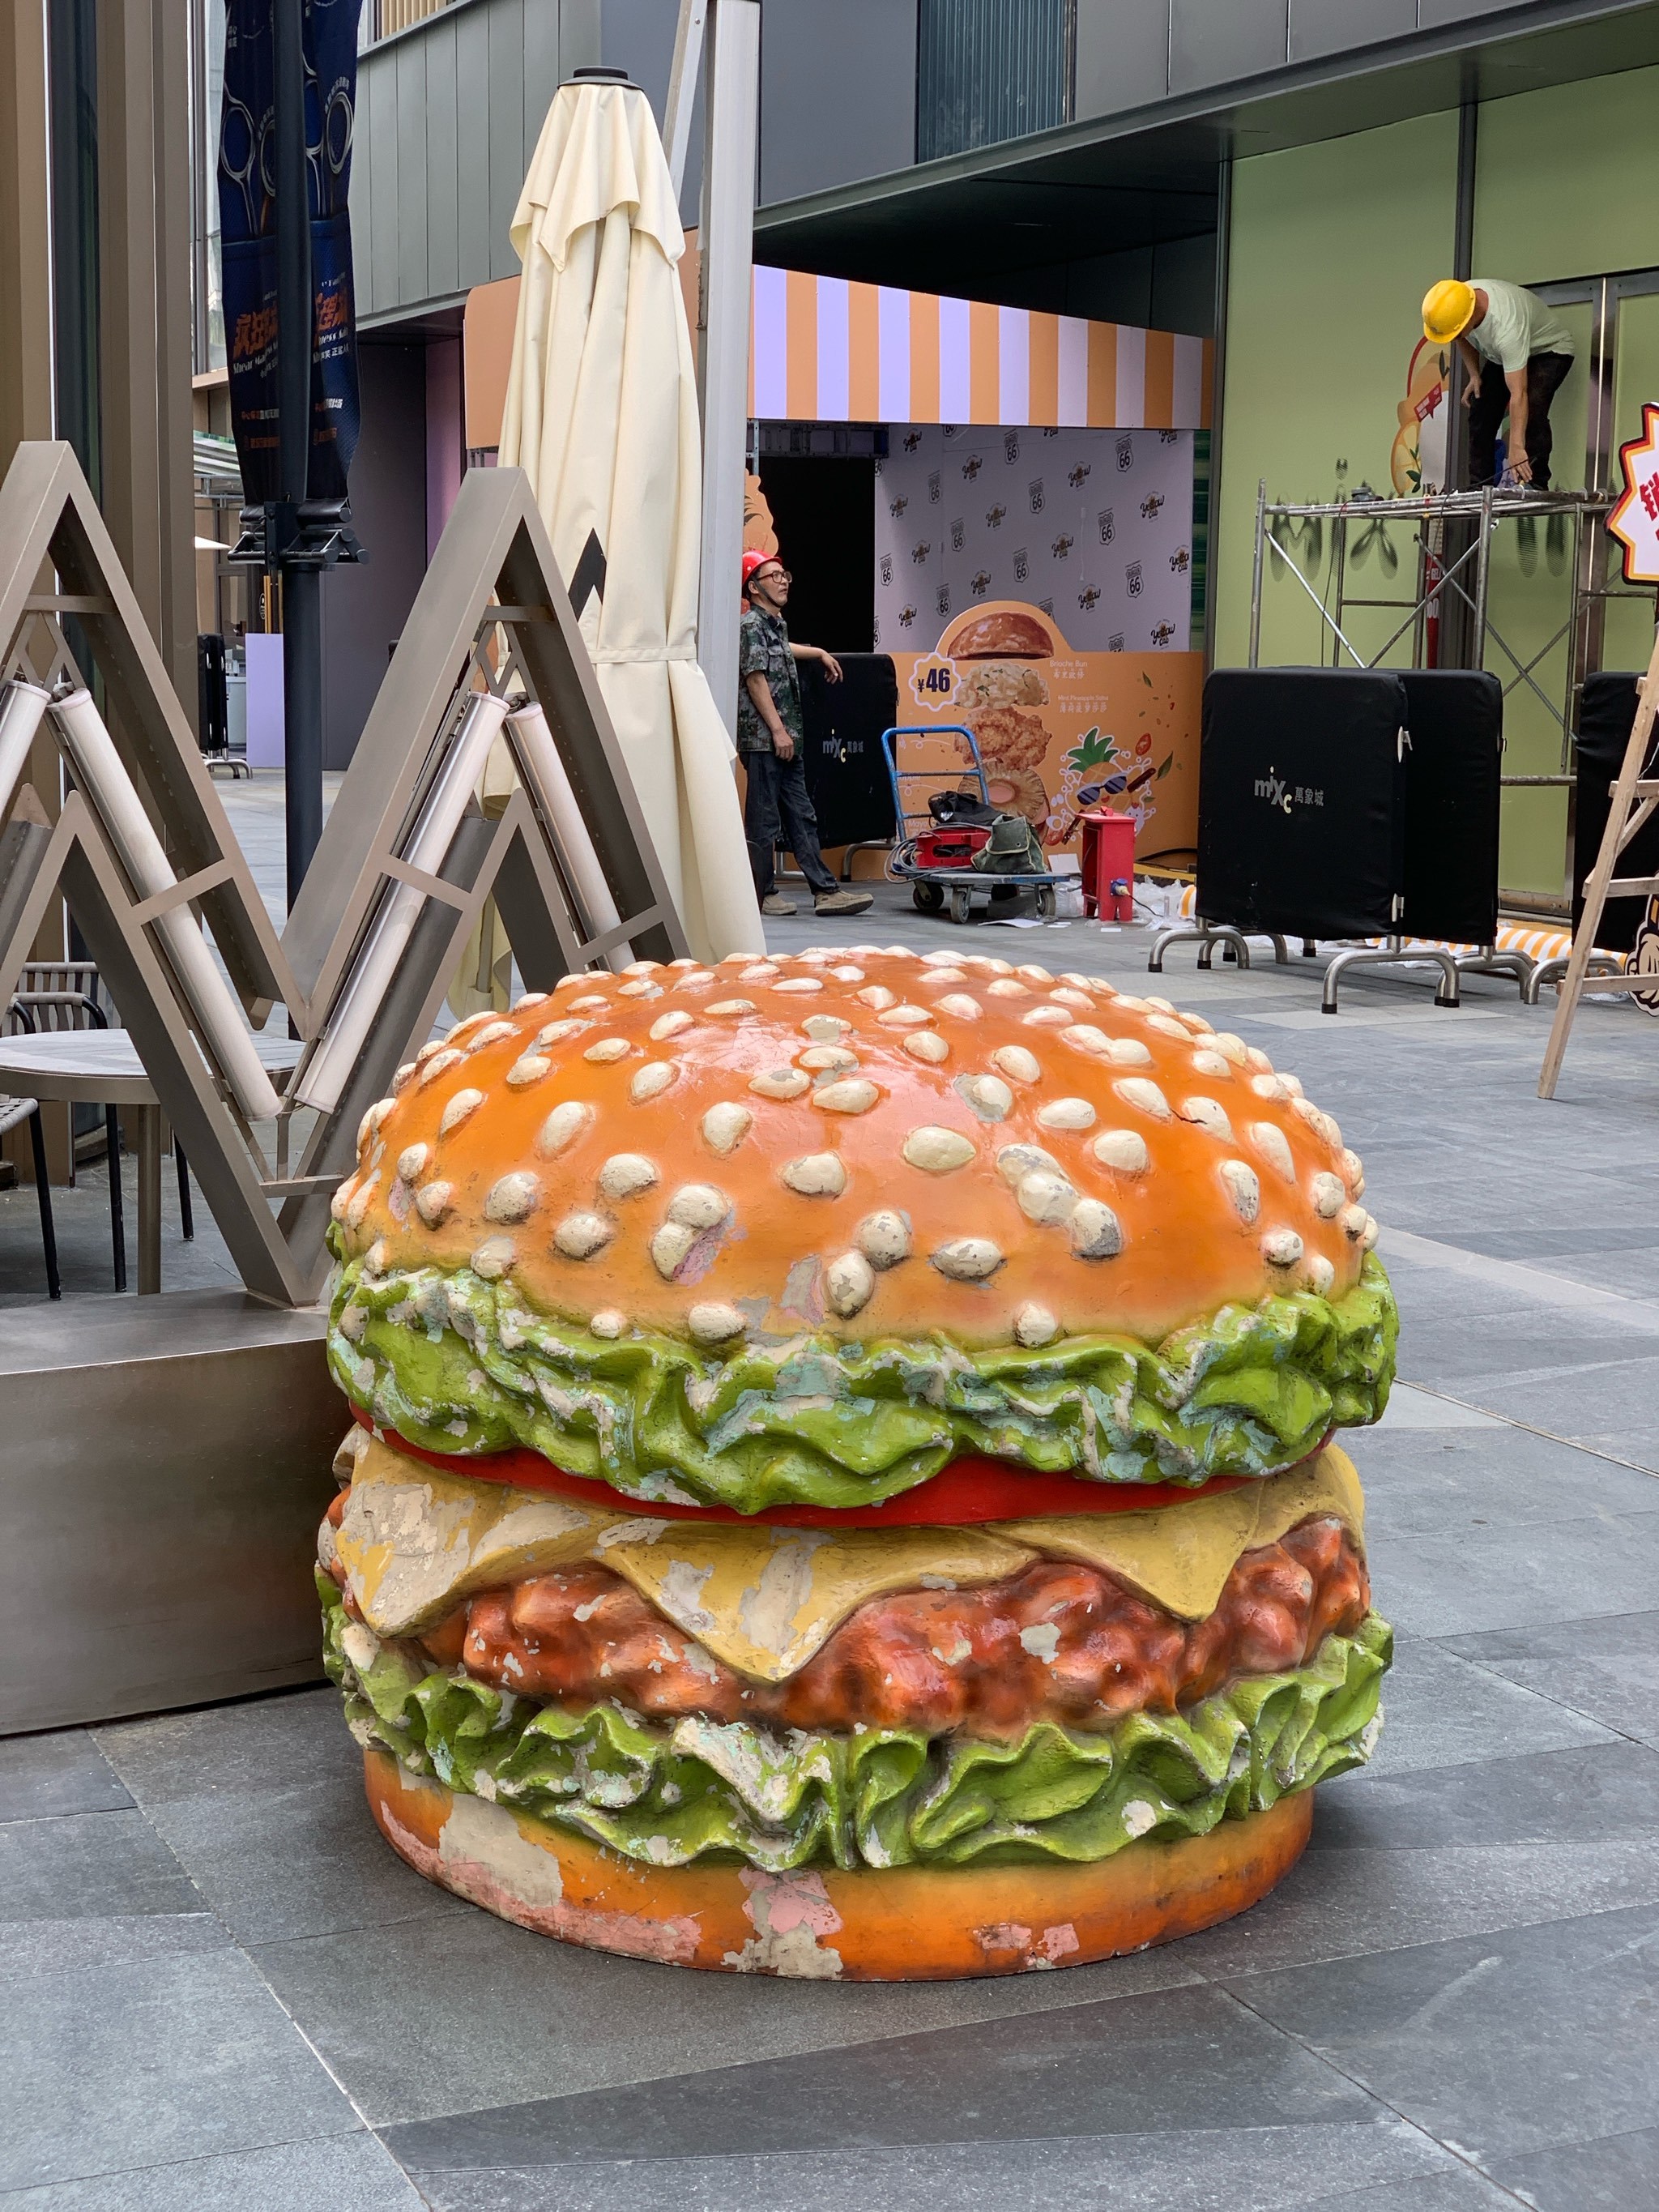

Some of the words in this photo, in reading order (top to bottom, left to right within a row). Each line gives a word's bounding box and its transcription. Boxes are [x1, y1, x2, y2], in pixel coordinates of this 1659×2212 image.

[1008, 444, 1017, 461] 66
[1120, 451, 1130, 468] 66
[931, 485, 940, 501] 66
[1032, 493, 1043, 510] 66
[1141, 495, 1164, 518] Yellow
[954, 532, 963, 548] 66
[1102, 524, 1112, 541] 66
[883, 568, 890, 583] 66
[1017, 563, 1026, 579] 66
[1129, 576, 1141, 594] 66
[940, 598, 949, 613] 66
[1151, 623, 1175, 645] Yellow
[1050, 660, 1073, 668] Brioche
[1075, 660, 1088, 668] Bun
[918, 668, 950, 693] ¥46
[1294, 786, 1324, 807] 萬象城
